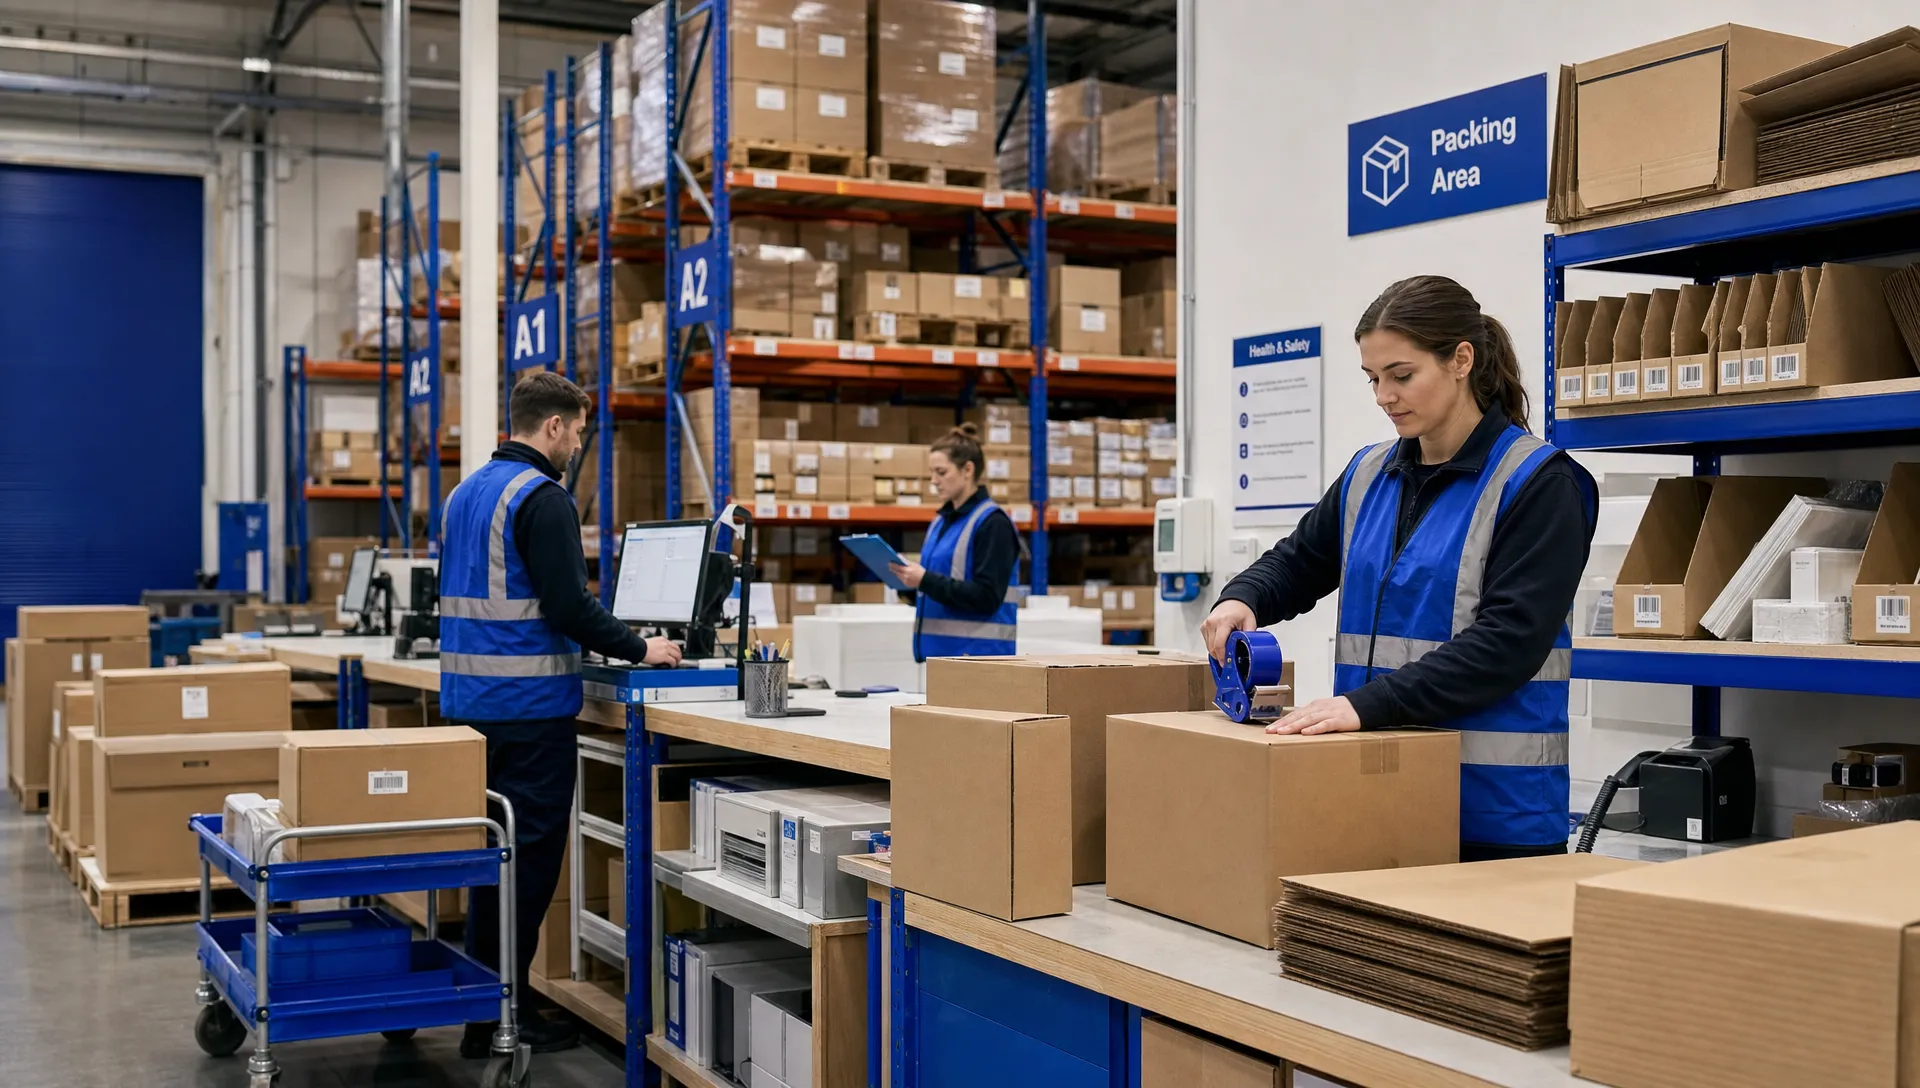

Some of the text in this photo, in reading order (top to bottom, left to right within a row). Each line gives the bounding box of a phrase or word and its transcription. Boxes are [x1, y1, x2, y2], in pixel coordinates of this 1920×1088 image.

[1431, 115, 1516, 155] Packing
[1431, 166, 1480, 195] Area
[680, 257, 709, 313] A2
[514, 308, 546, 360] A1
[1250, 338, 1310, 358] Health & Safety
[409, 356, 431, 397] A2
